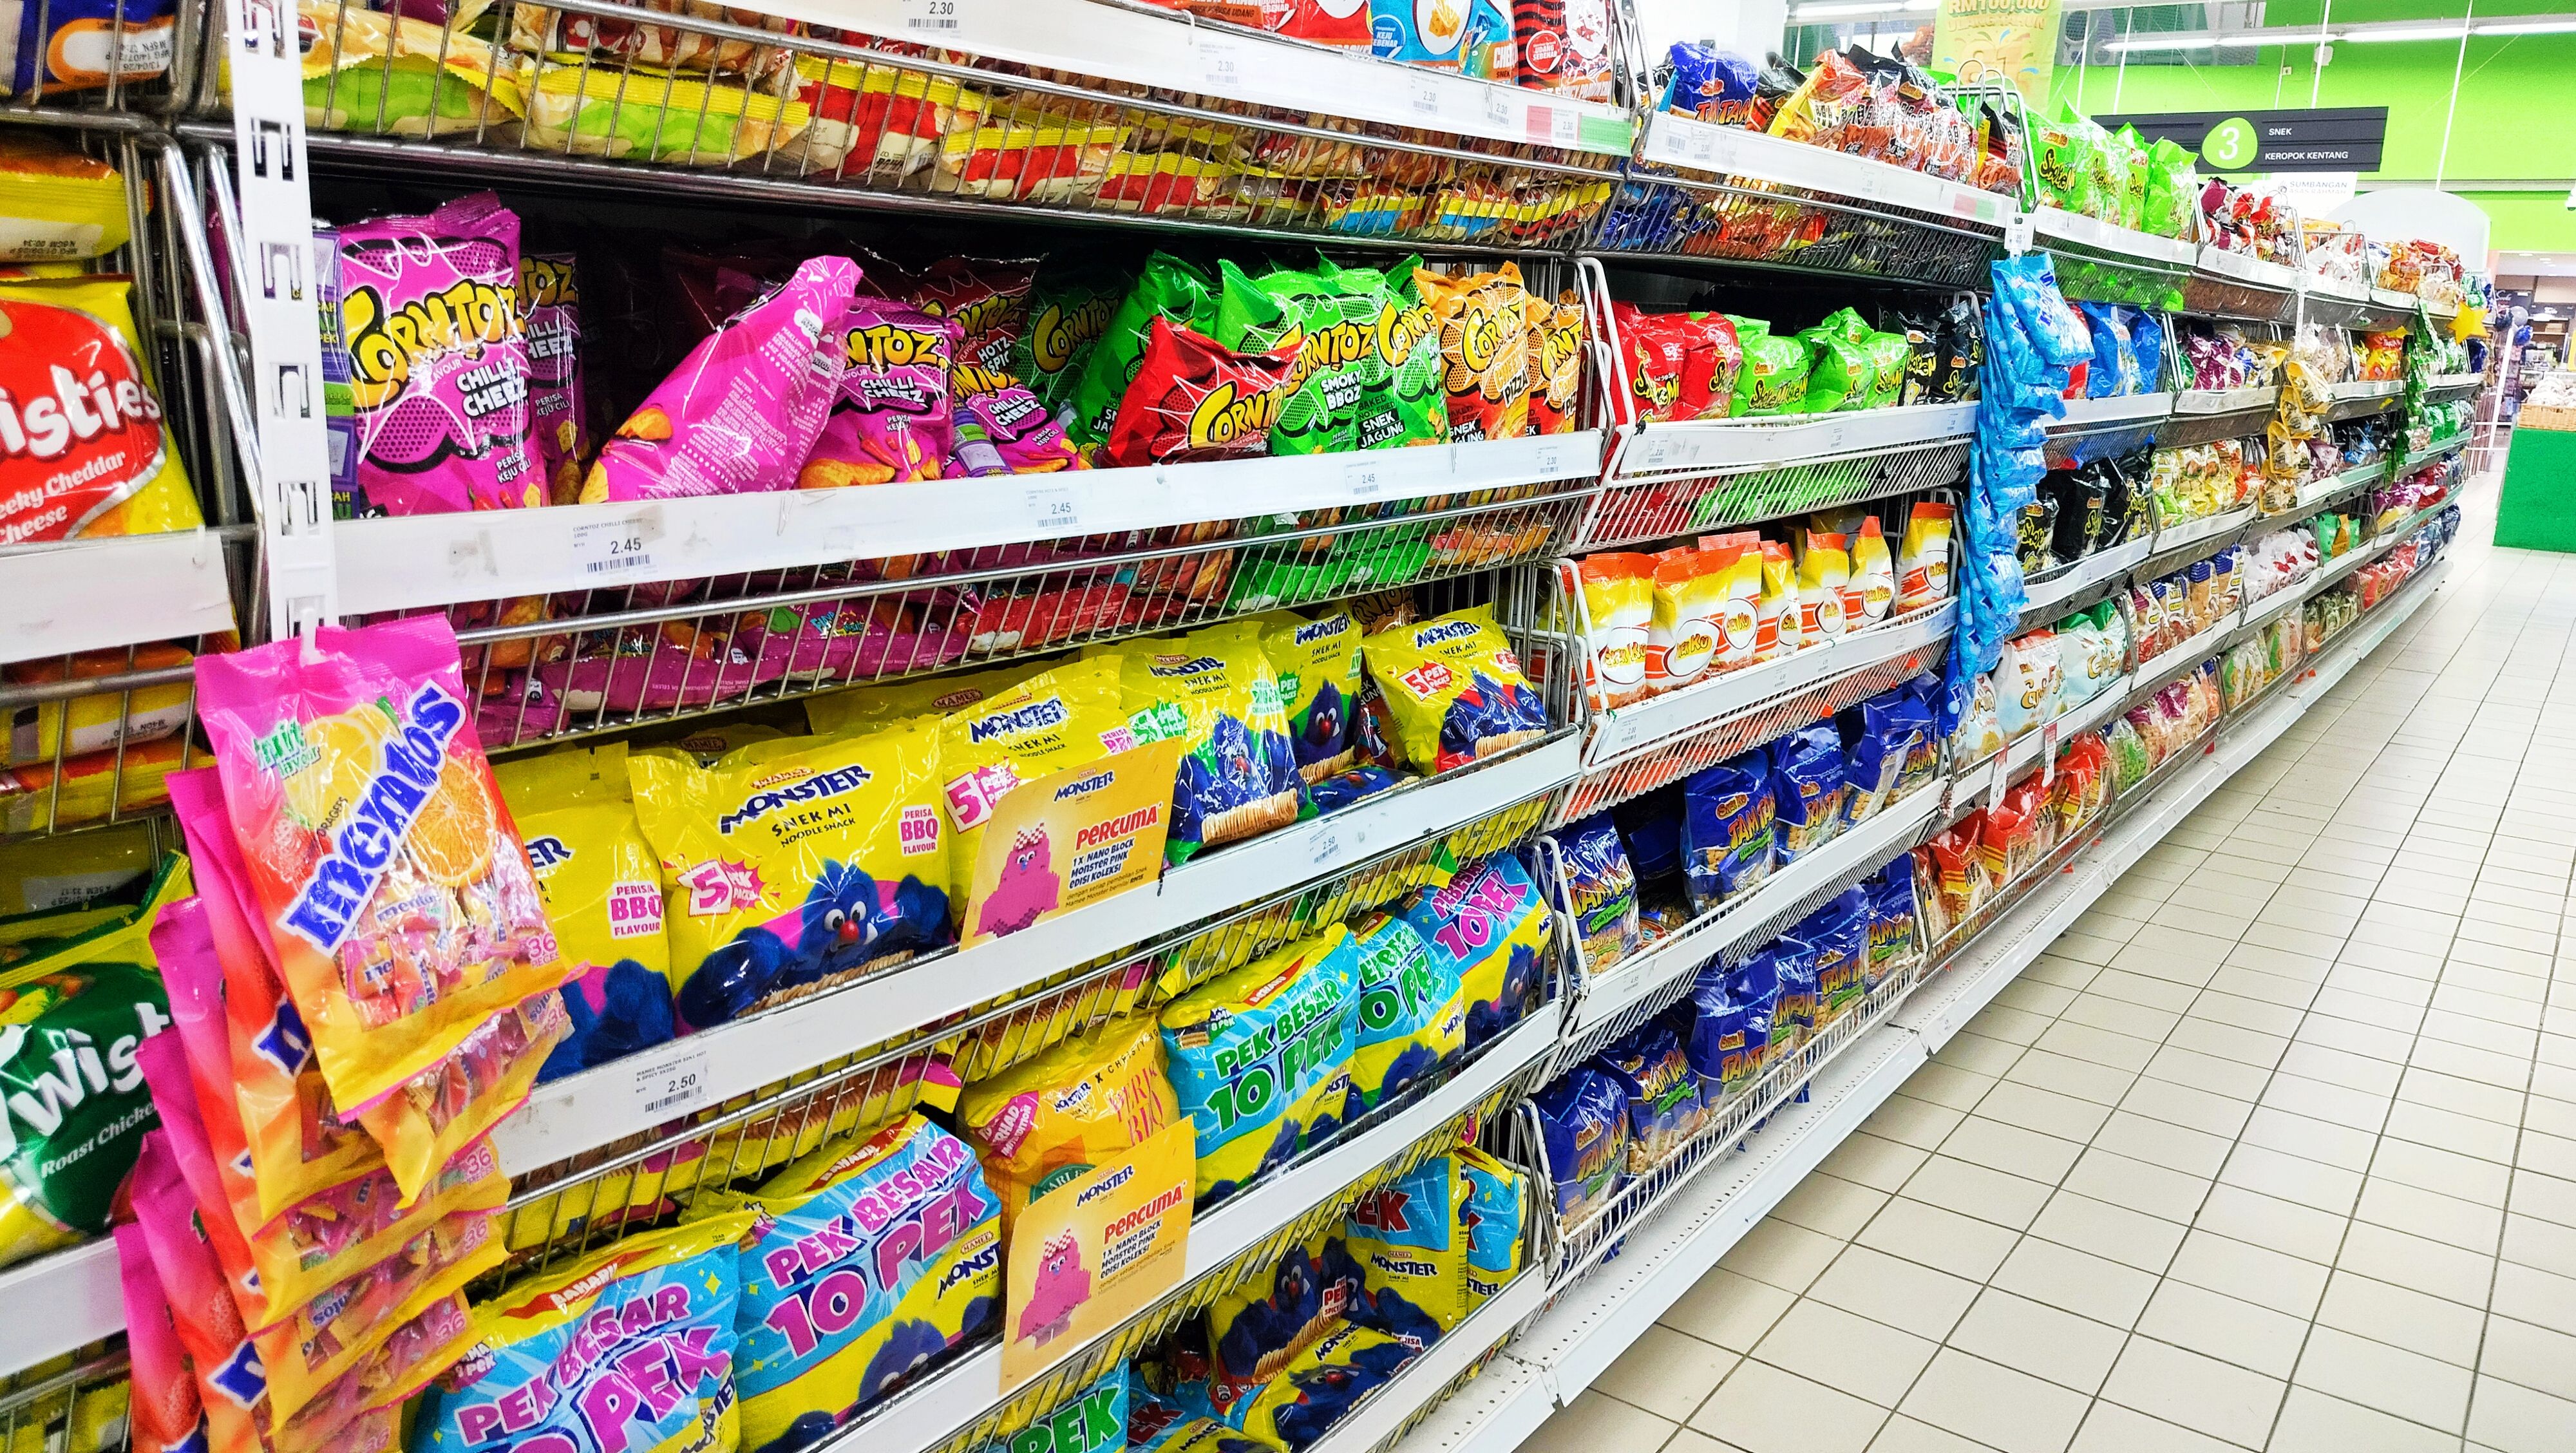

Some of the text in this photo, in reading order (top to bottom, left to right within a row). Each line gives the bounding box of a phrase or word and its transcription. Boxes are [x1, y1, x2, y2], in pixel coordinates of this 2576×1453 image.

[929, 2, 953, 15] 2.30
[1376, 31, 1392, 40] KEJU
[1218, 61, 1234, 72] 2.30
[1423, 91, 1437, 102] 2.30
[1496, 103, 1508, 115] 2.30
[2219, 127, 2240, 160] 3
[2268, 128, 2292, 136] SNEK
[2265, 151, 2349, 161] KEROPOK KENTANG
[2289, 181, 2348, 189] SUMBANGAN
[977, 337, 1011, 363] HOTZ
[456, 357, 519, 392] CHILLI
[860, 375, 914, 390] CHILLI
[1320, 370, 1362, 393] SMOKY
[462, 378, 529, 418] CHEEZ
[535, 394, 564, 408] PERISA
[863, 388, 925, 403] CHEEZ
[1325, 386, 1361, 411] BBQZ
[1358, 394, 1388, 411] BAKED
[1505, 375, 1528, 405] PIZZA
[988, 394, 1025, 415] CHILLI
[995, 399, 1041, 426] CHEEZ
[1358, 401, 1396, 419] NOT FRIED
[1360, 421, 1405, 448] JAGUNG
[1362, 412, 1396, 432] SNEK
[1449, 422, 1477, 437] SNEK
[44, 451, 126, 491] Cheddar
[497, 466, 518, 484] KEJU
[1363, 473, 1376, 484] 2.45
[1052, 502, 1072, 515] 2.45
[611, 537, 641, 555] 2.45
[1295, 612, 1351, 646] MONSTER
[1311, 641, 1341, 658] SNEK MI
[1424, 662, 1448, 681] PEK
[1428, 672, 1451, 688] PACKS
[1279, 676, 1298, 696] PEK
[1409, 672, 1431, 698] 5
[970, 696, 1068, 743] MONSTER
[1101, 728, 1128, 741] PERISA
[1052, 770, 1115, 802] MONSTER
[719, 764, 874, 835] MONSTER
[950, 782, 982, 827] 5
[287, 685, 466, 953] mentos
[772, 802, 853, 839] SNEK MI
[904, 807, 933, 820] PERISA
[780, 817, 857, 849] NOODLE SNACK
[900, 818, 939, 842] BBQ
[1075, 804, 1159, 851] PERCUMA
[1728, 806, 1761, 850] TAM
[903, 842, 938, 855] FLAVOUR
[1086, 846, 1109, 863] NANO
[1110, 837, 1135, 855] BLOCK
[1322, 836, 1336, 850] 2.50
[1068, 862, 1122, 889] EDISI KOLEKSI
[1070, 851, 1129, 878] MONSTER PINK
[616, 883, 654, 897] PERISA
[690, 866, 729, 910] 5
[611, 893, 663, 923] BBQ
[613, 922, 661, 936] FLAVOUR
[1436, 907, 1491, 960] 10
[527, 931, 556, 958] 36
[1820, 964, 1851, 996] TAM
[1214, 979, 1343, 1079] PEK BESAR
[668, 1073, 697, 1094] 2.50
[1206, 1068, 1275, 1132] 10
[1283, 1010, 1350, 1094] PEK
[41, 1136, 95, 1180] Roast
[466, 1146, 493, 1177] 36
[1075, 1165, 1134, 1208] MONSTER
[764, 1135, 973, 1289] PEK BESAR
[1103, 1189, 1183, 1245] PERCUMA
[464, 1220, 489, 1252] 36
[1115, 1219, 1162, 1253] NANO BLOCK
[1099, 1245, 1150, 1279] EDISI KOLEKSI
[1101, 1231, 1157, 1270] MONSTER PINK
[763, 1182, 990, 1359] 10 PEK
[1370, 1251, 1439, 1277] MONSTER
[436, 1309, 466, 1342] 36
[455, 1282, 694, 1448] PEK BESAR
